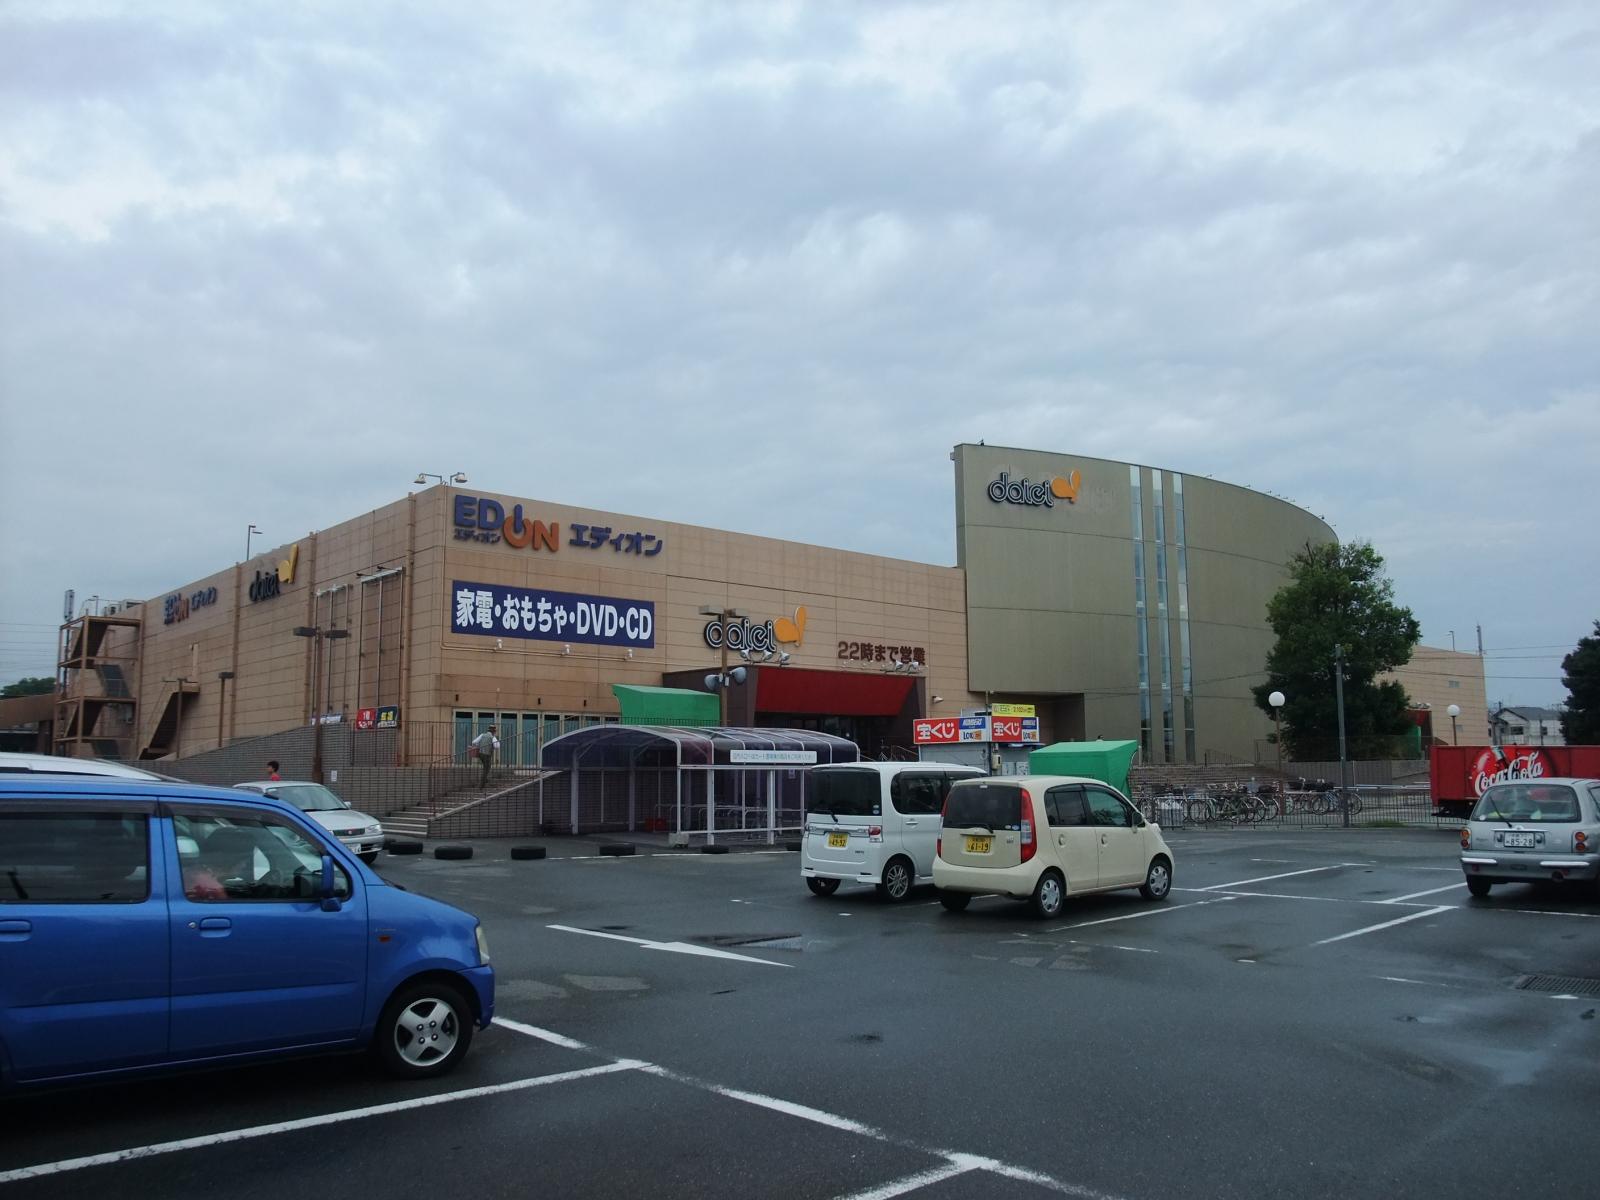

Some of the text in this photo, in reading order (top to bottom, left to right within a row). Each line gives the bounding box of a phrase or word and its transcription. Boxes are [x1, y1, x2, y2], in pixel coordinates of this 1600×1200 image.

[988, 472, 1054, 508] daiei
[454, 494, 560, 552] EDION
[569, 523, 663, 556] エディオン
[703, 614, 777, 653] daiei
[838, 641, 926, 666] 22時まで営業
[917, 722, 955, 740] 宝くじ
[993, 721, 1020, 736] 宝くじ
[1510, 838, 1533, 847] 85-28
